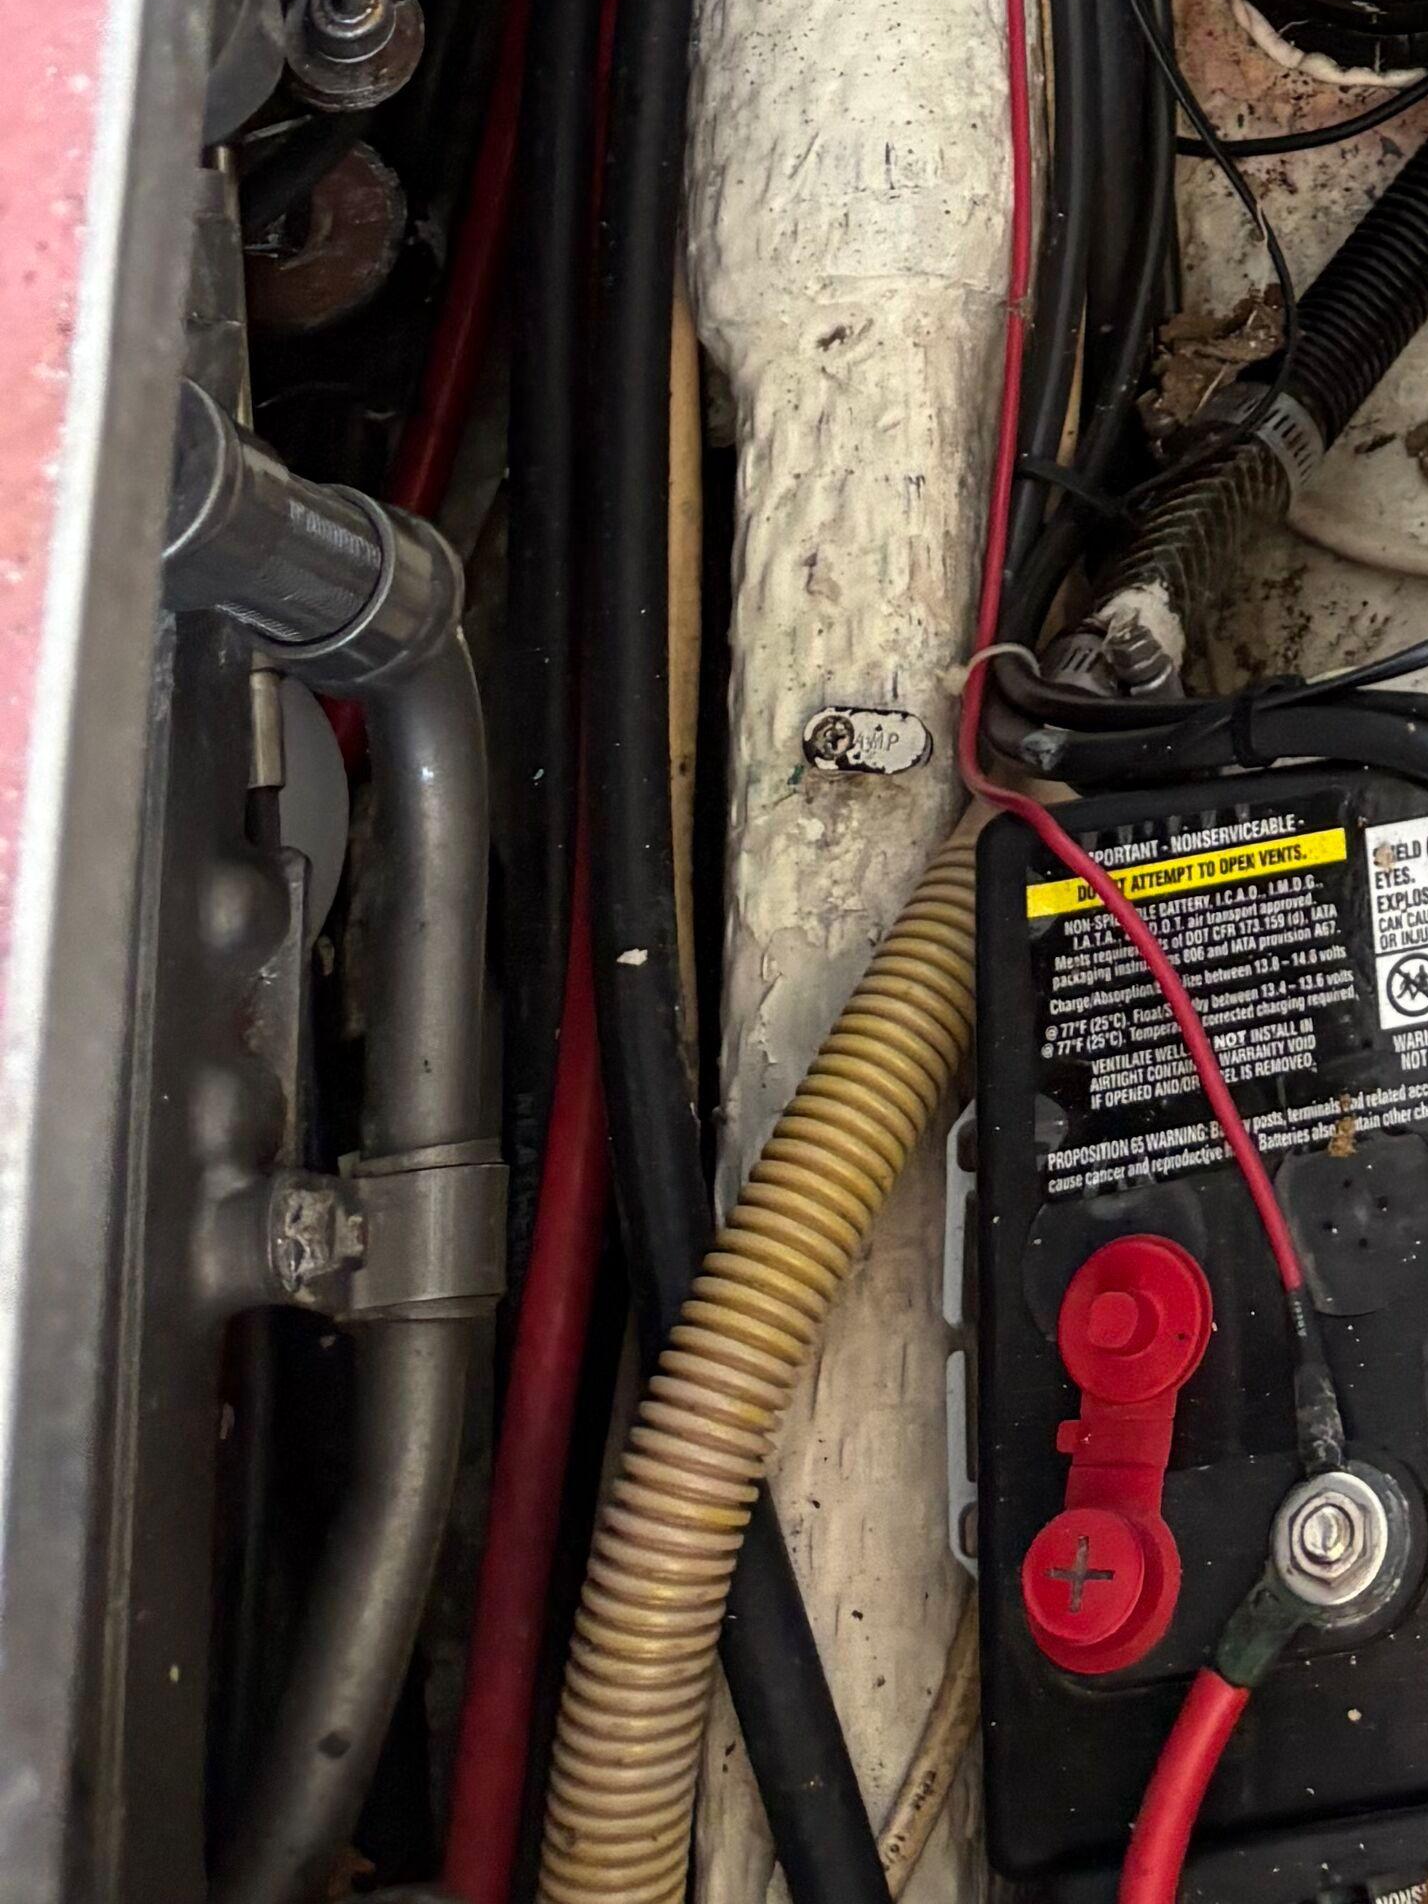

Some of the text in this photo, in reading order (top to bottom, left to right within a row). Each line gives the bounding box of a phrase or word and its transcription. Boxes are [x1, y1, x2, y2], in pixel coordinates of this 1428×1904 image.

[1090, 813, 1297, 870] PORTANT NONSERVICEABLE
[1076, 842, 1307, 903] DO ATTEMPT TO OPEN VENTS.
[1373, 865, 1416, 890] EYES.
[1185, 912, 1206, 931] air
[1205, 902, 1259, 927] transport
[1376, 913, 1404, 933] CAN
[1378, 931, 1399, 950] OR
[1211, 1028, 1247, 1051] NOT
[1248, 1019, 1297, 1043] INSTALL
[1298, 1016, 1314, 1034] IN
